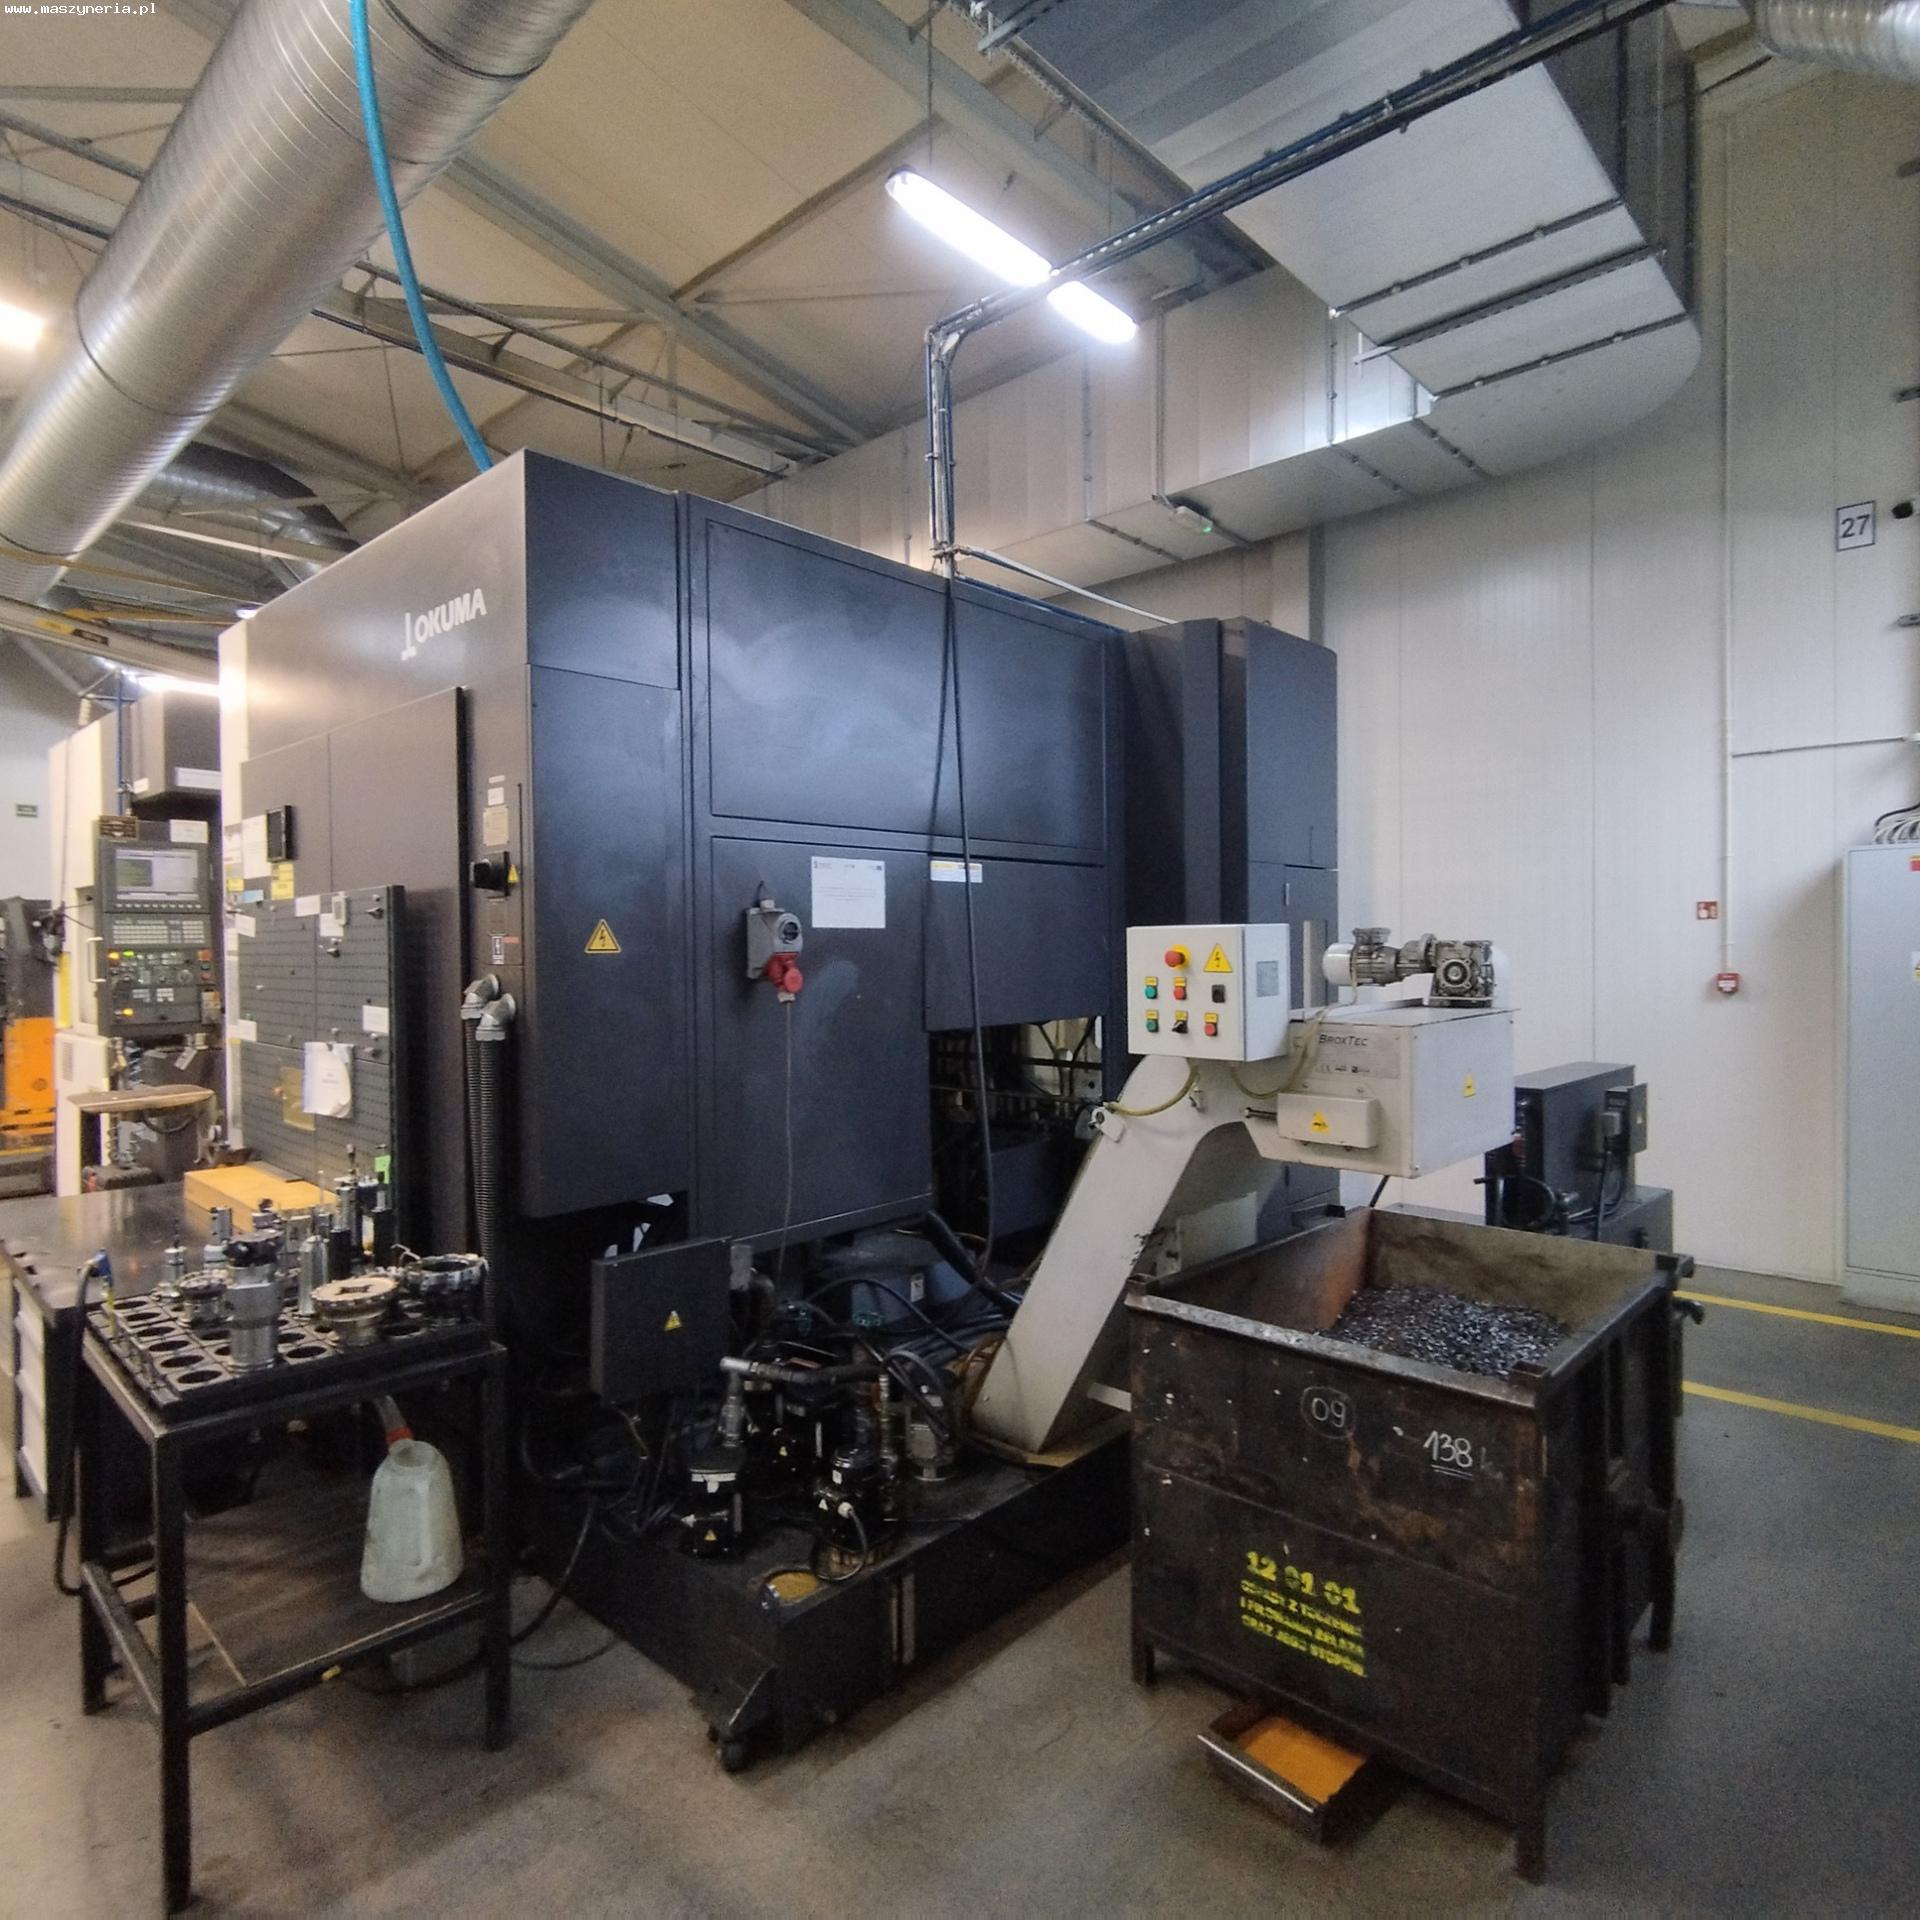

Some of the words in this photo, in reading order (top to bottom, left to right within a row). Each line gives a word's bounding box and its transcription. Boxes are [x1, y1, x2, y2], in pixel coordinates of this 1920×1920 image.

[1841, 514, 1870, 538] 27
[414, 587, 488, 644] OKUMA
[1312, 1397, 1346, 1428] 09
[1423, 1430, 1473, 1468] 138
[1246, 1551, 1277, 1581] 12
